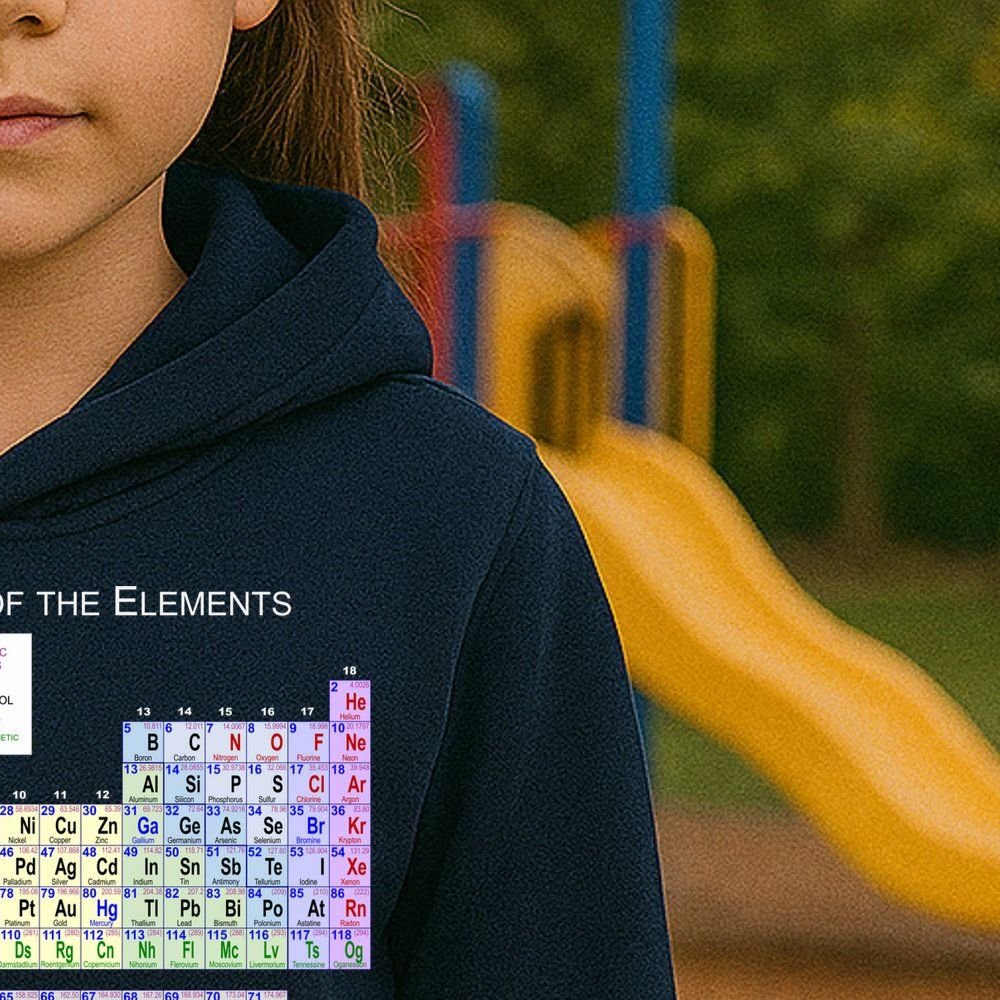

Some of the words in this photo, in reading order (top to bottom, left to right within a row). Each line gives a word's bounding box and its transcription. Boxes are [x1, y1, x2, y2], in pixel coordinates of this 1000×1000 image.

[36, 591, 100, 616] THE
[342, 665, 357, 676] 18
[331, 683, 338, 691] 2
[346, 692, 366, 711] He
[136, 706, 151, 717] 13
[177, 706, 193, 716] 14
[218, 706, 233, 717] 15
[260, 706, 275, 717] 16
[300, 706, 315, 716] 17
[164, 723, 173, 734] 6
[206, 724, 214, 732] 7
[189, 733, 201, 752] C
[230, 733, 241, 751] N
[173, 753, 196, 761] Carbon
[213, 754, 239, 762] Nitrogen
[290, 765, 303, 774] 17
[308, 775, 325, 793] Cl
[12, 790, 27, 800] 10
[53, 790, 67, 800] 11
[95, 789, 110, 800] 12
[0, 806, 13, 815] 28
[82, 806, 96, 815] 30
[290, 806, 303, 815] 35
[20, 816, 36, 835] Ni
[97, 816, 118, 835] Zn
[307, 816, 326, 835] Br
[164, 847, 179, 858] 50
[331, 848, 344, 856] 54
[180, 857, 200, 876] Sn
[347, 857, 367, 876] Xe
[165, 889, 178, 898] 82
[180, 899, 201, 918] Pb
